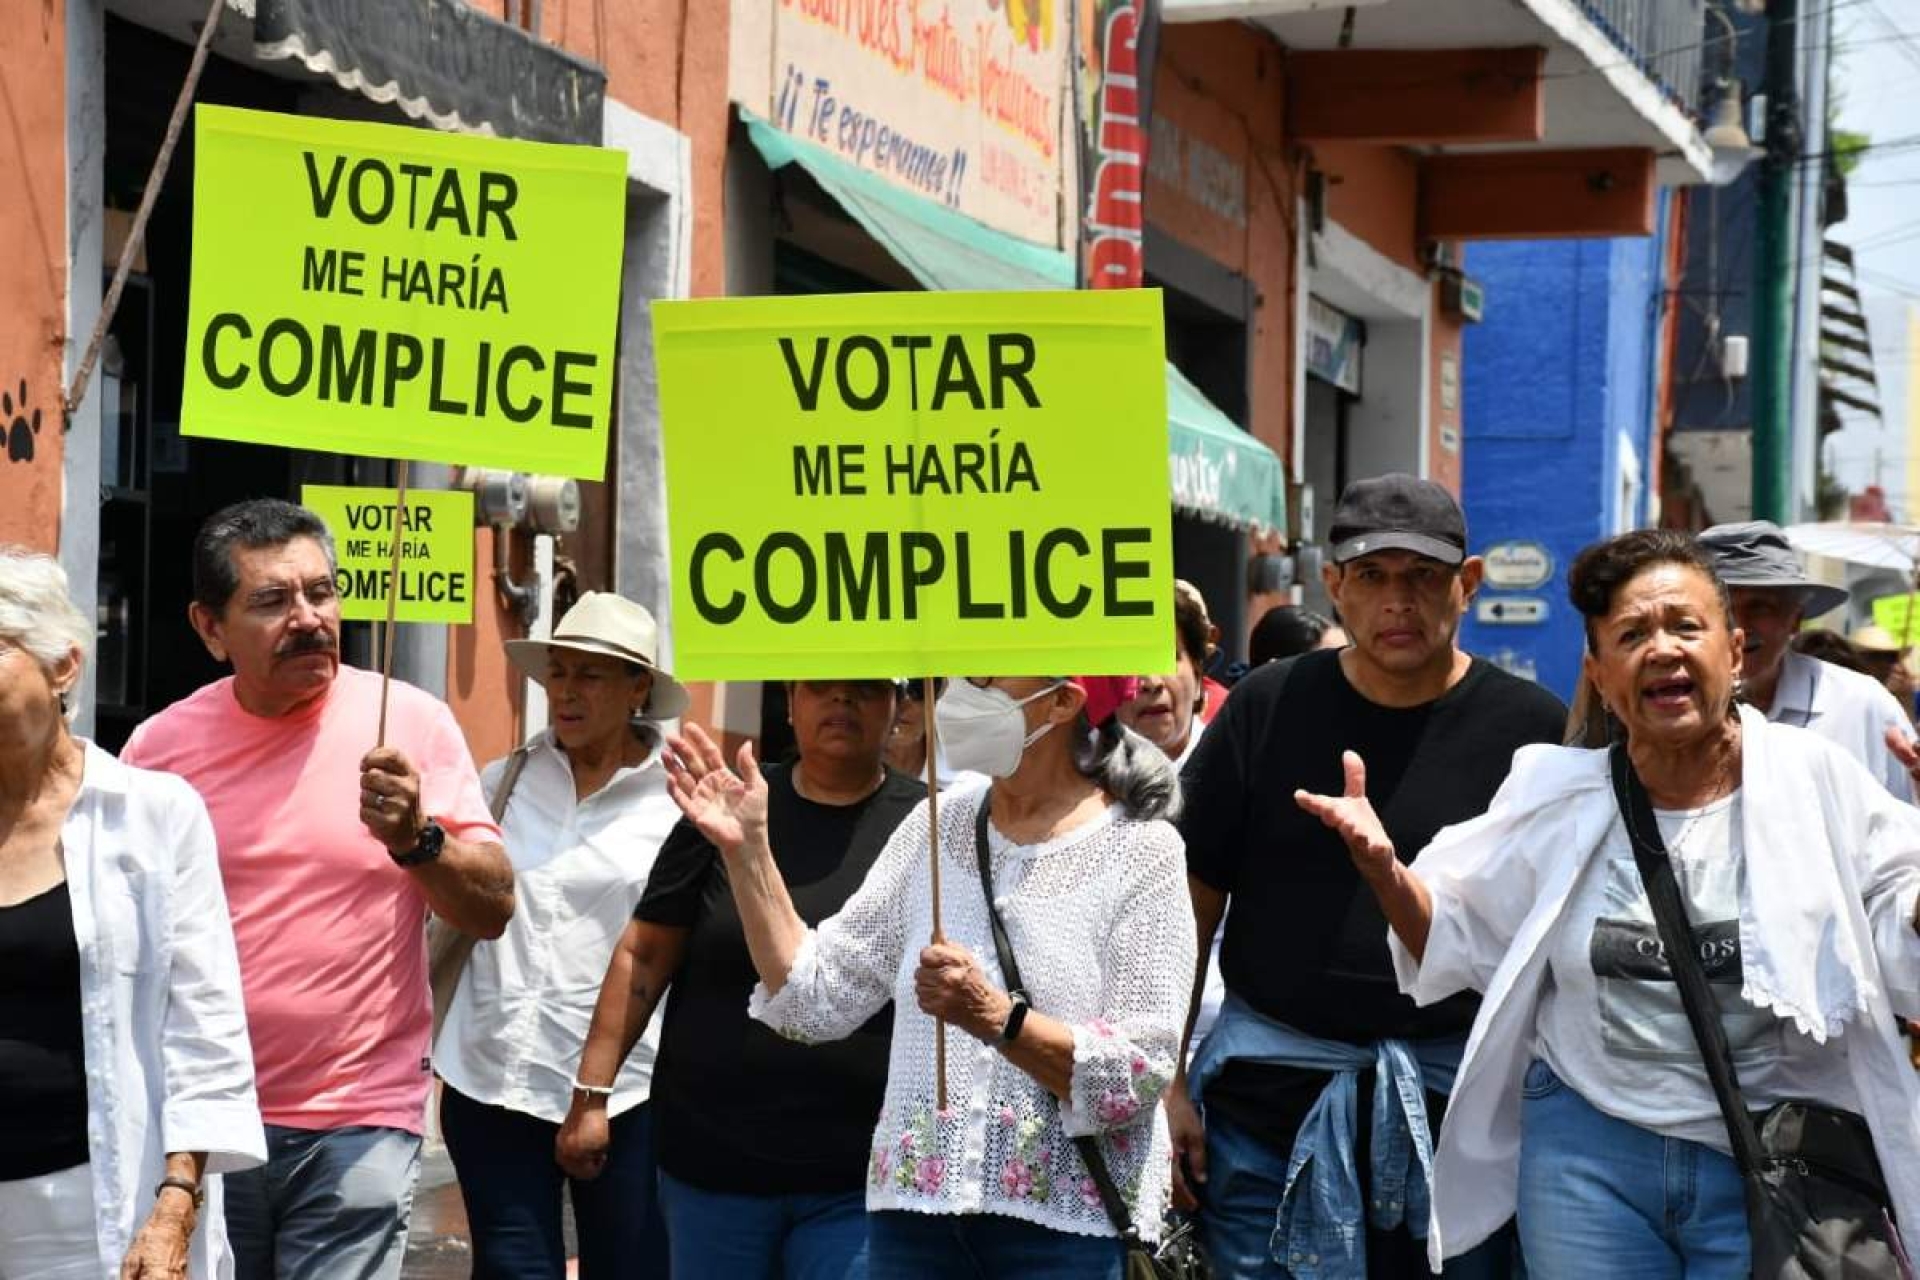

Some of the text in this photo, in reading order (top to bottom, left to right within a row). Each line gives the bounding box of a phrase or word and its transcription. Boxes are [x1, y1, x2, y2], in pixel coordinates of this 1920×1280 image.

[808, 77, 836, 144] Te
[303, 151, 518, 241] VOTAR
[302, 246, 509, 314] ME HARÍA
[202, 313, 597, 429] COMPLICE
[778, 333, 1042, 412] VOTAR
[793, 428, 1041, 496] ME HARÍA
[346, 540, 372, 558] ME
[689, 528, 1155, 625] COMPLICE
[336, 568, 466, 603] OMPLICE
